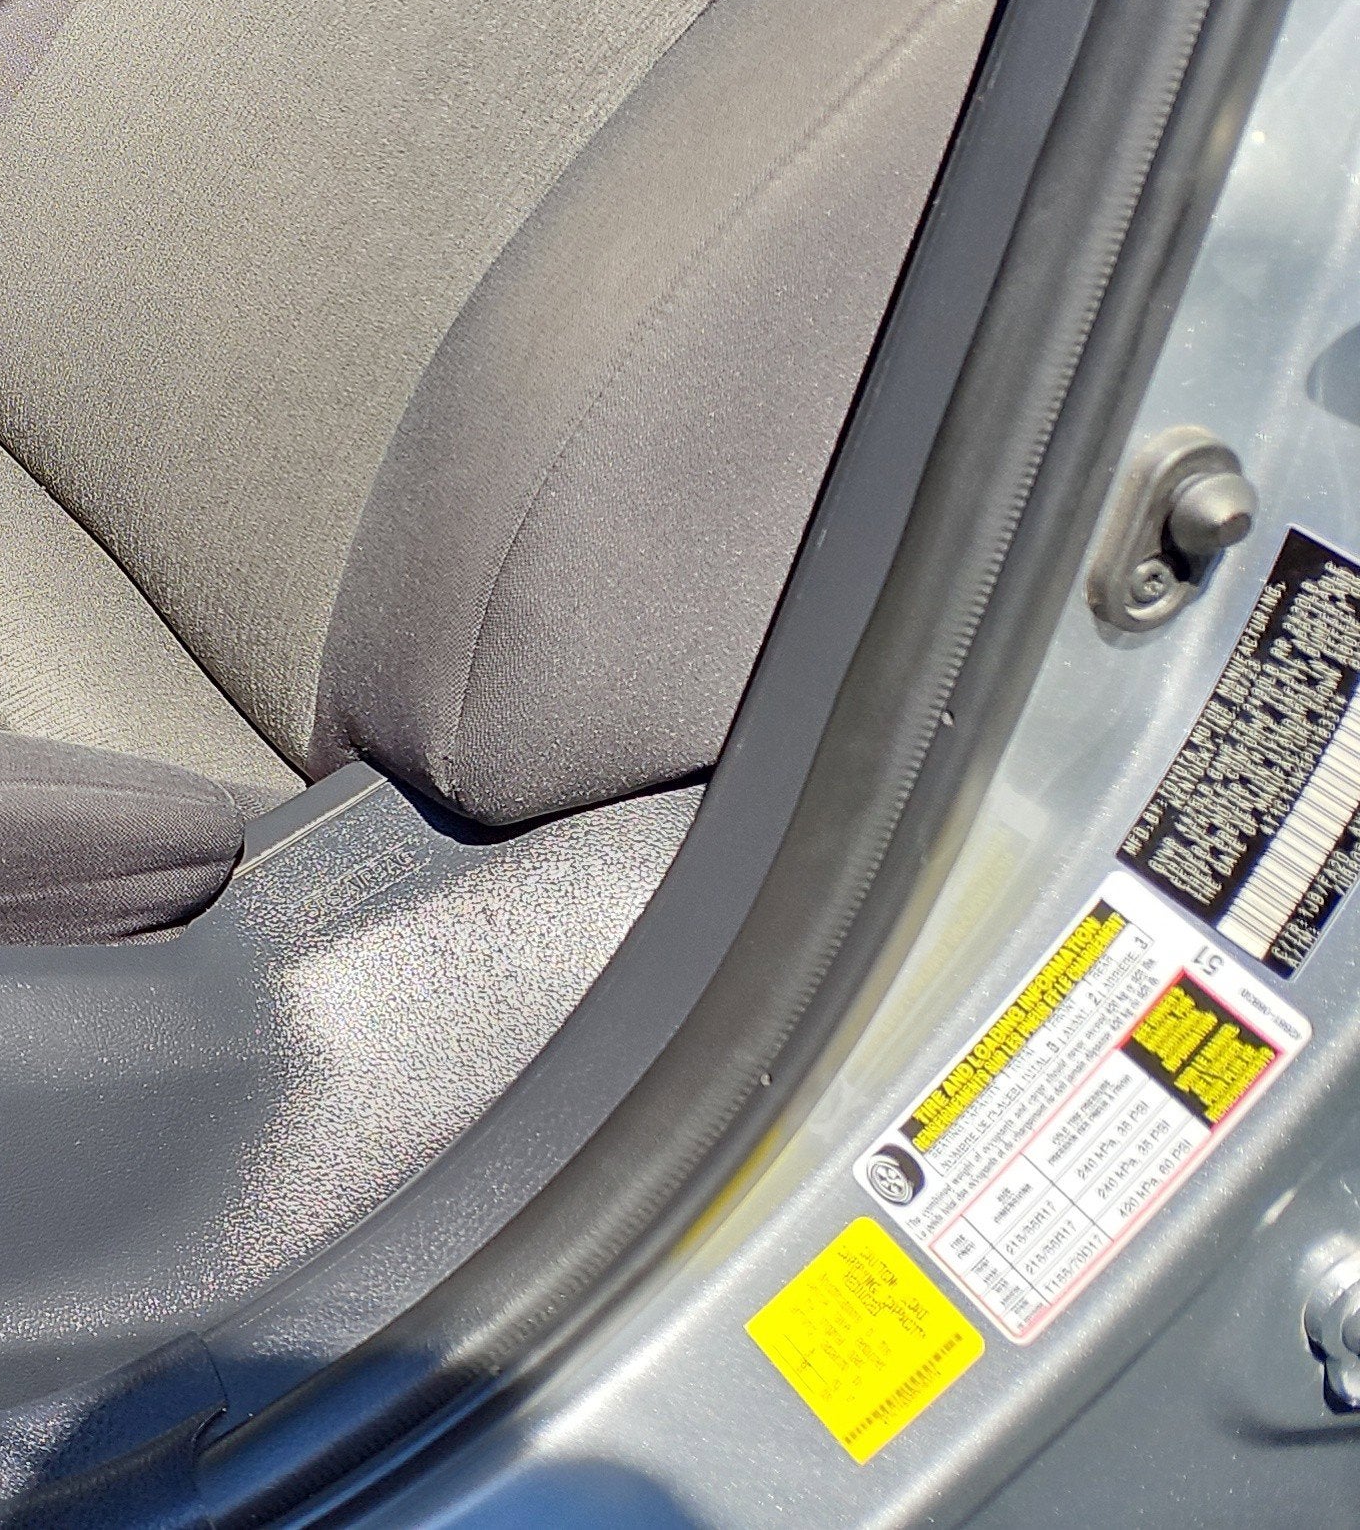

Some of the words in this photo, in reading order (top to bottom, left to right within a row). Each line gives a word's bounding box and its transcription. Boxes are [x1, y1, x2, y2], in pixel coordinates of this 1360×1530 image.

[1188, 699, 1225, 747] MOTOR
[1190, 943, 1226, 979] 51
[1085, 990, 1102, 1007] 2
[912, 1088, 949, 1127] TIRE
[939, 1059, 976, 1098] AND
[964, 1002, 1027, 1069] LOADING
[1016, 913, 1102, 1012] INFORMATION
[982, 1047, 1011, 1077] SUR
[999, 1029, 1027, 1057] LES
[1015, 999, 1053, 1039] PNEUS
[1052, 972, 1075, 995] LE
[1074, 1156, 1098, 1180] 240
[1095, 1175, 1119, 1200] 240
